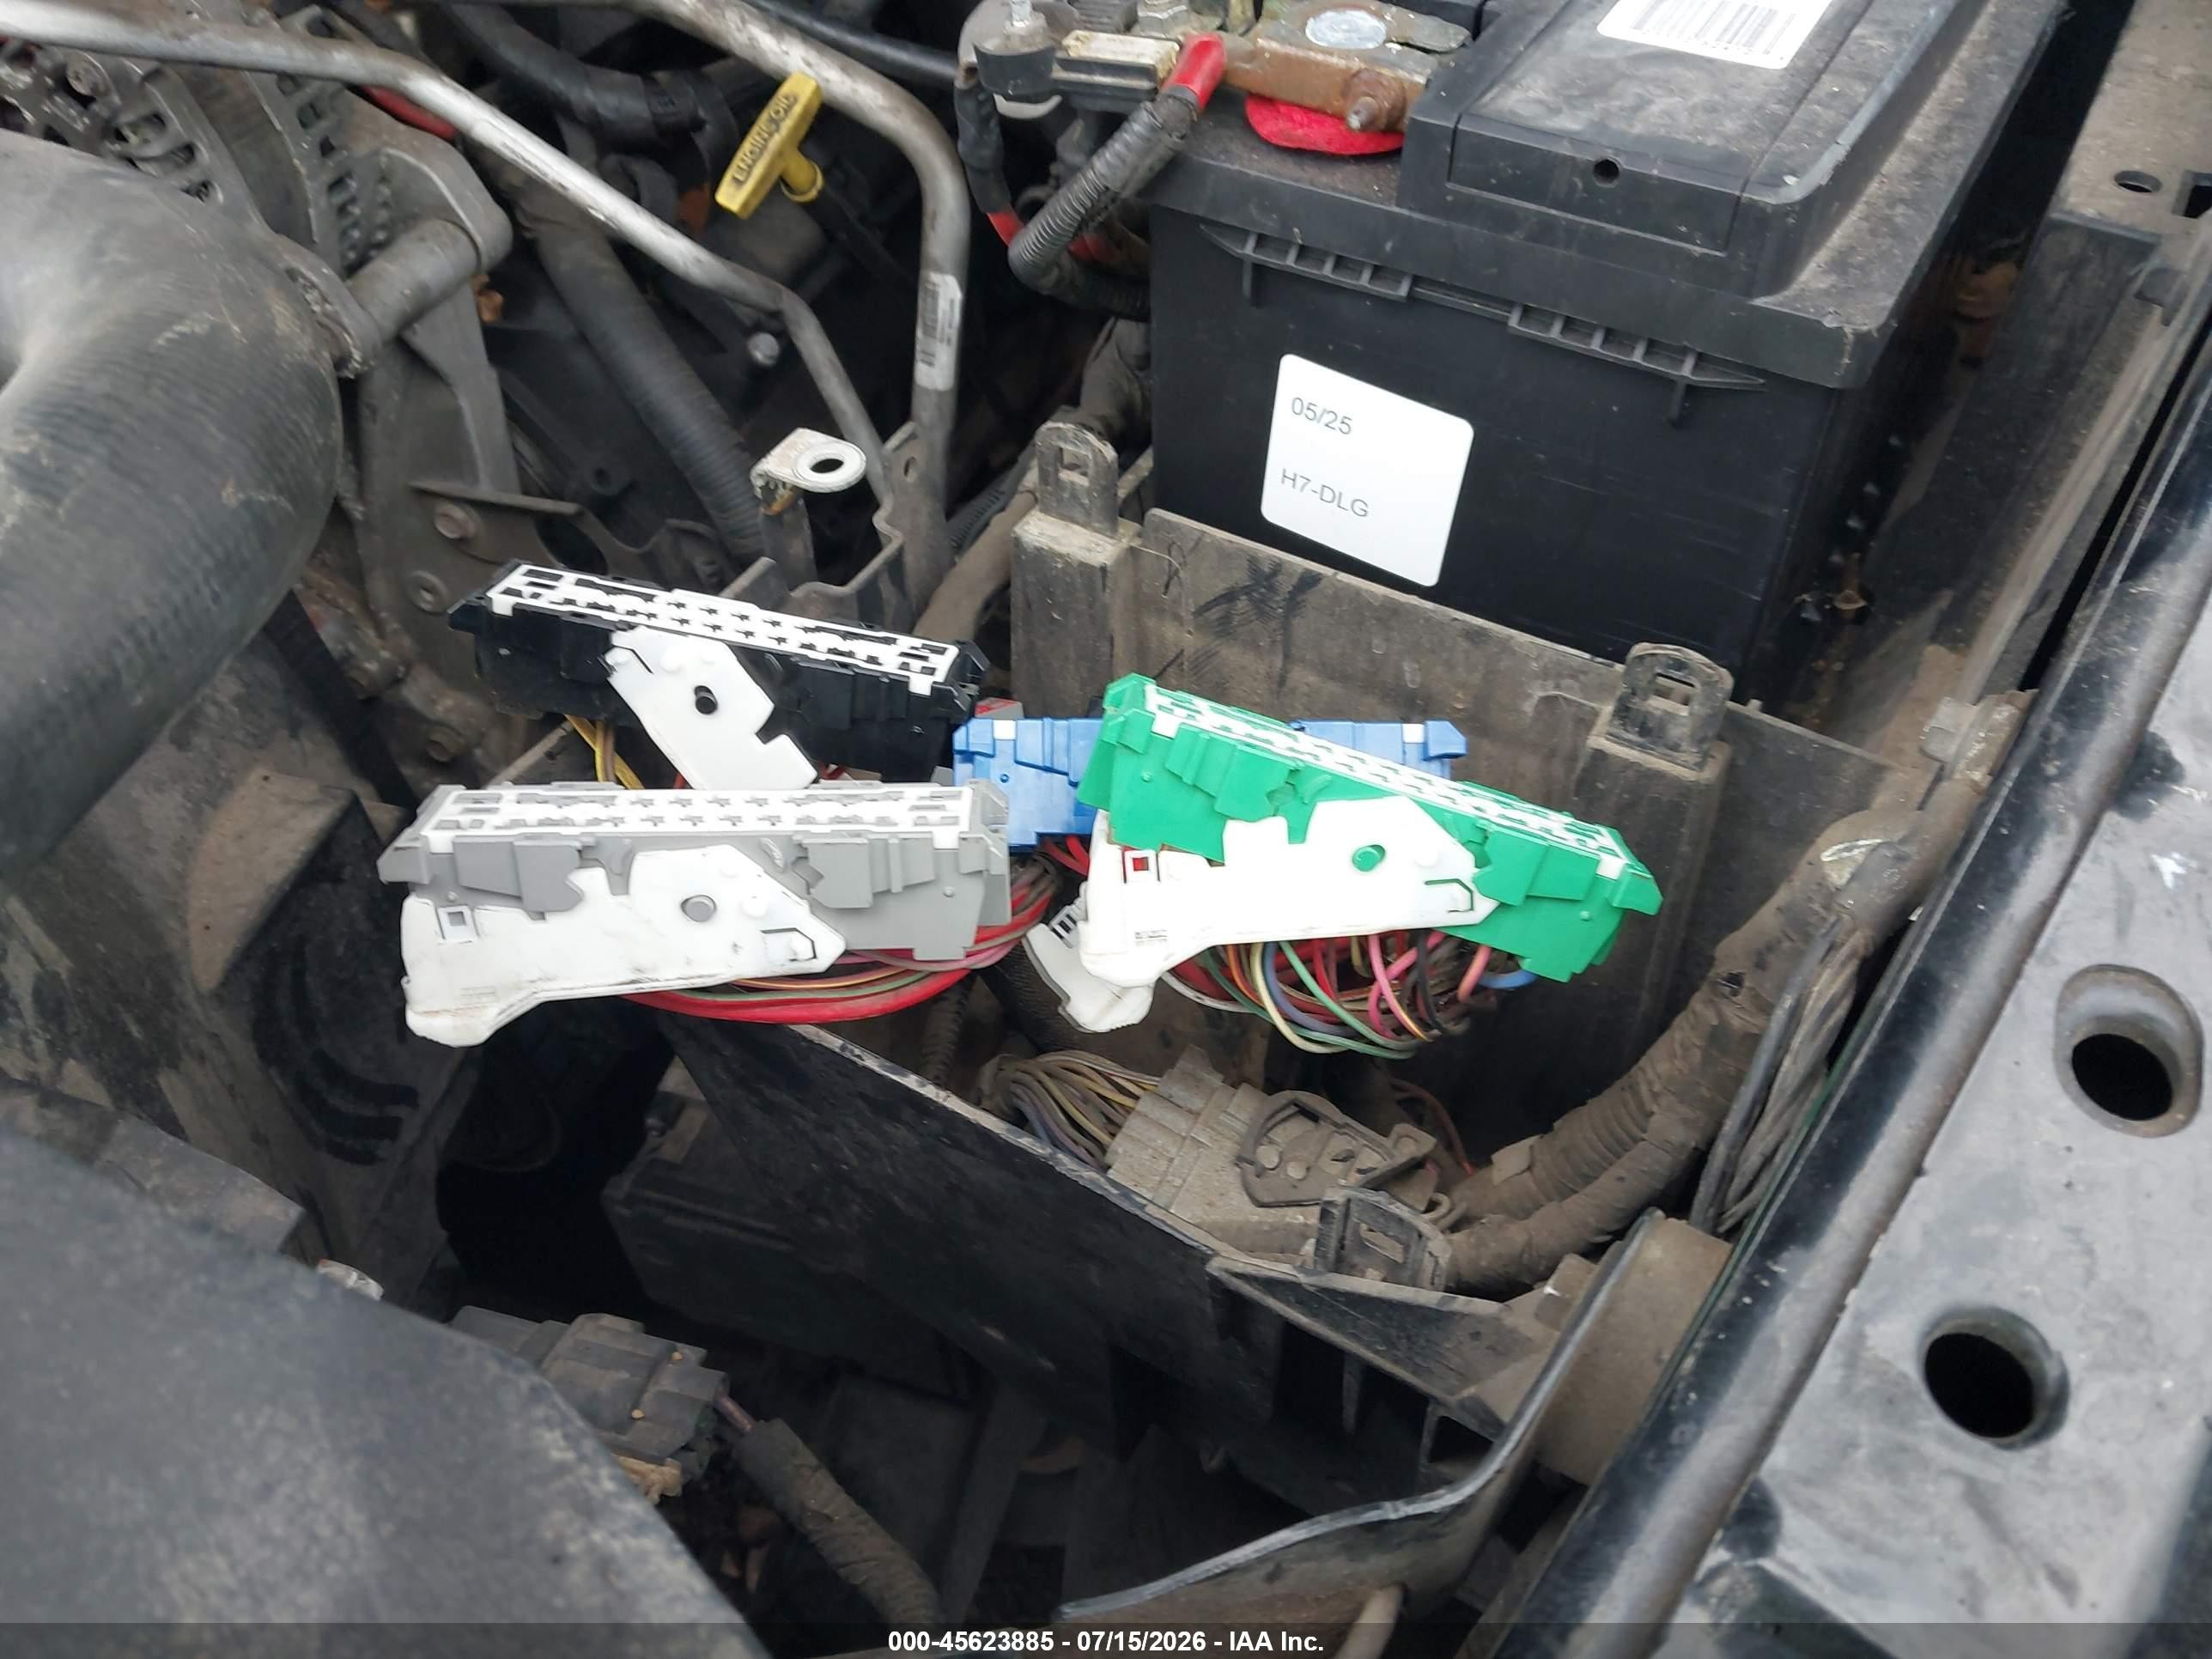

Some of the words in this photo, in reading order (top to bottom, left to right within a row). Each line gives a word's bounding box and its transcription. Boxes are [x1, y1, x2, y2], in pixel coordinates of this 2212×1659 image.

[770, 92, 799, 120] OIL
[1291, 397, 1353, 434] 05/25
[1281, 468, 1369, 517] H7-DLG
